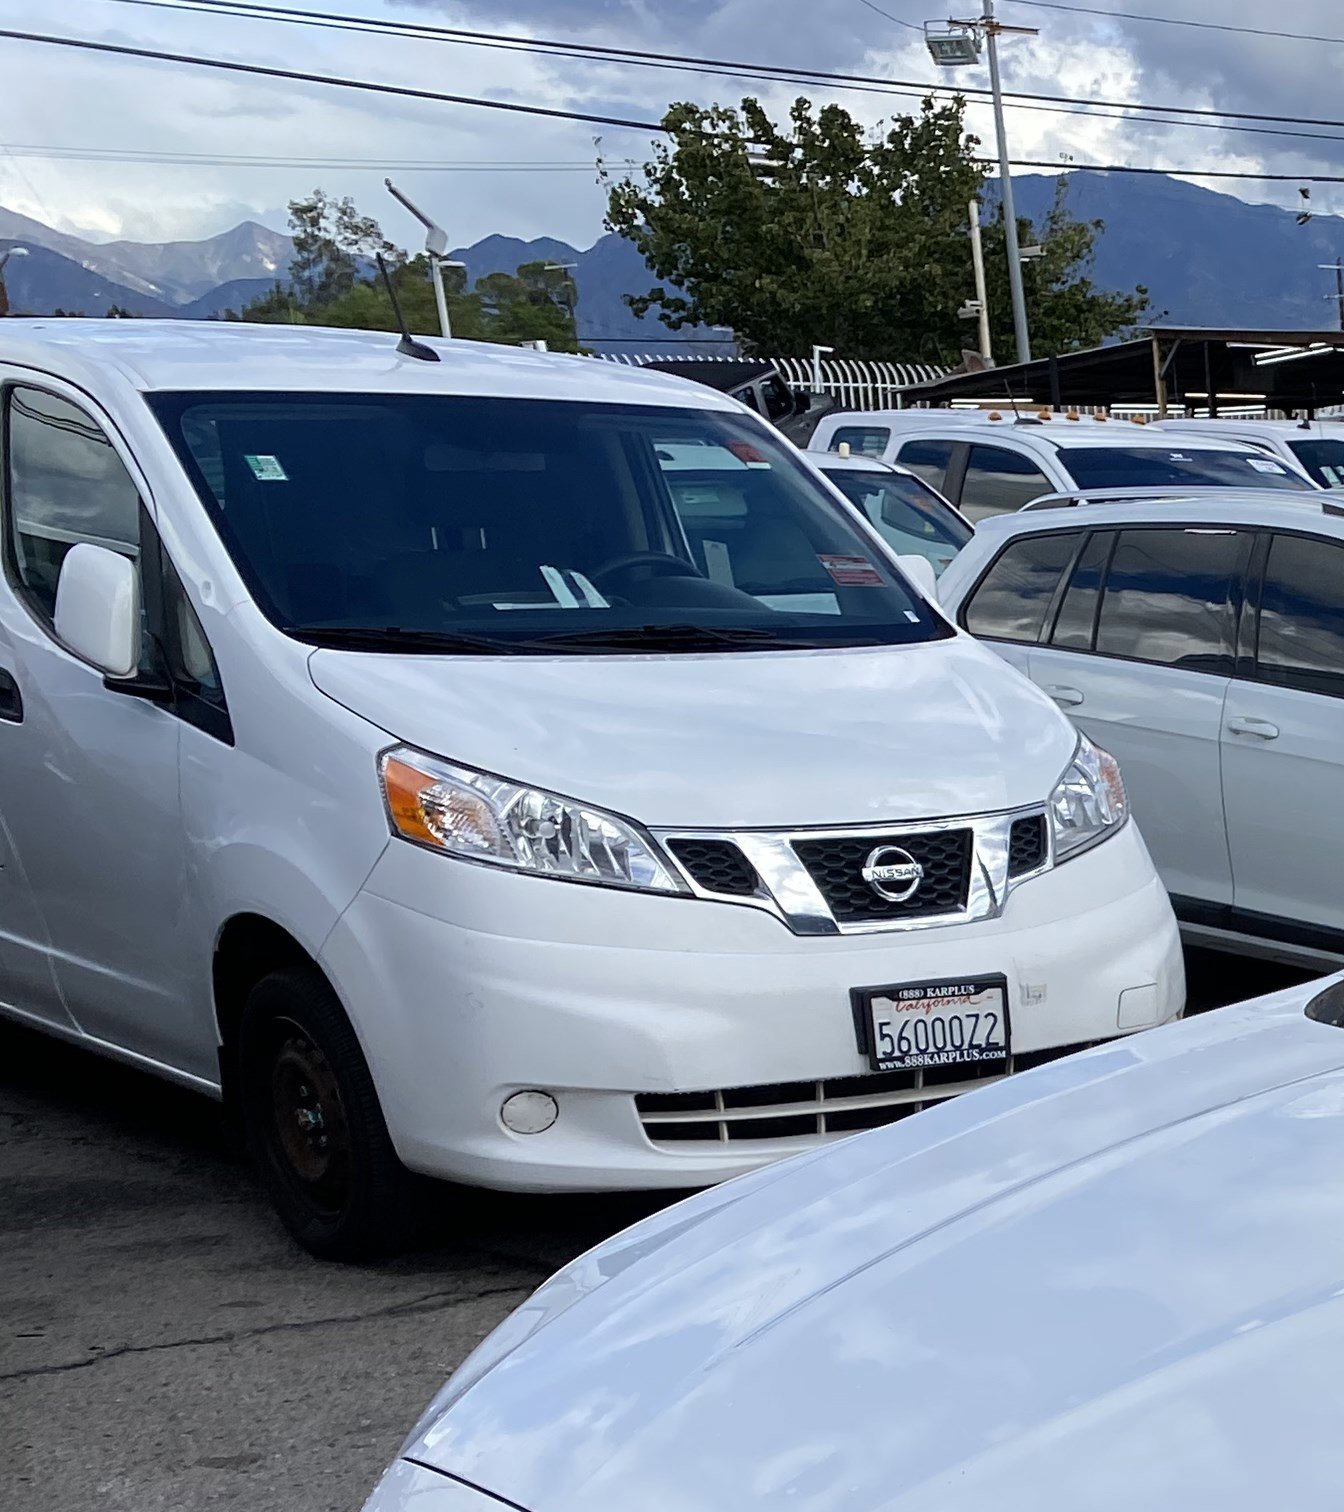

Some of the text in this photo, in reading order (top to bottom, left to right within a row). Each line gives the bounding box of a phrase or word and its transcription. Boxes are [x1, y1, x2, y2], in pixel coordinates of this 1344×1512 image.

[871, 867, 919, 879] NISSAN
[899, 984, 975, 999] (888) KARPLUS
[878, 1012, 1000, 1058] 56000Z2
